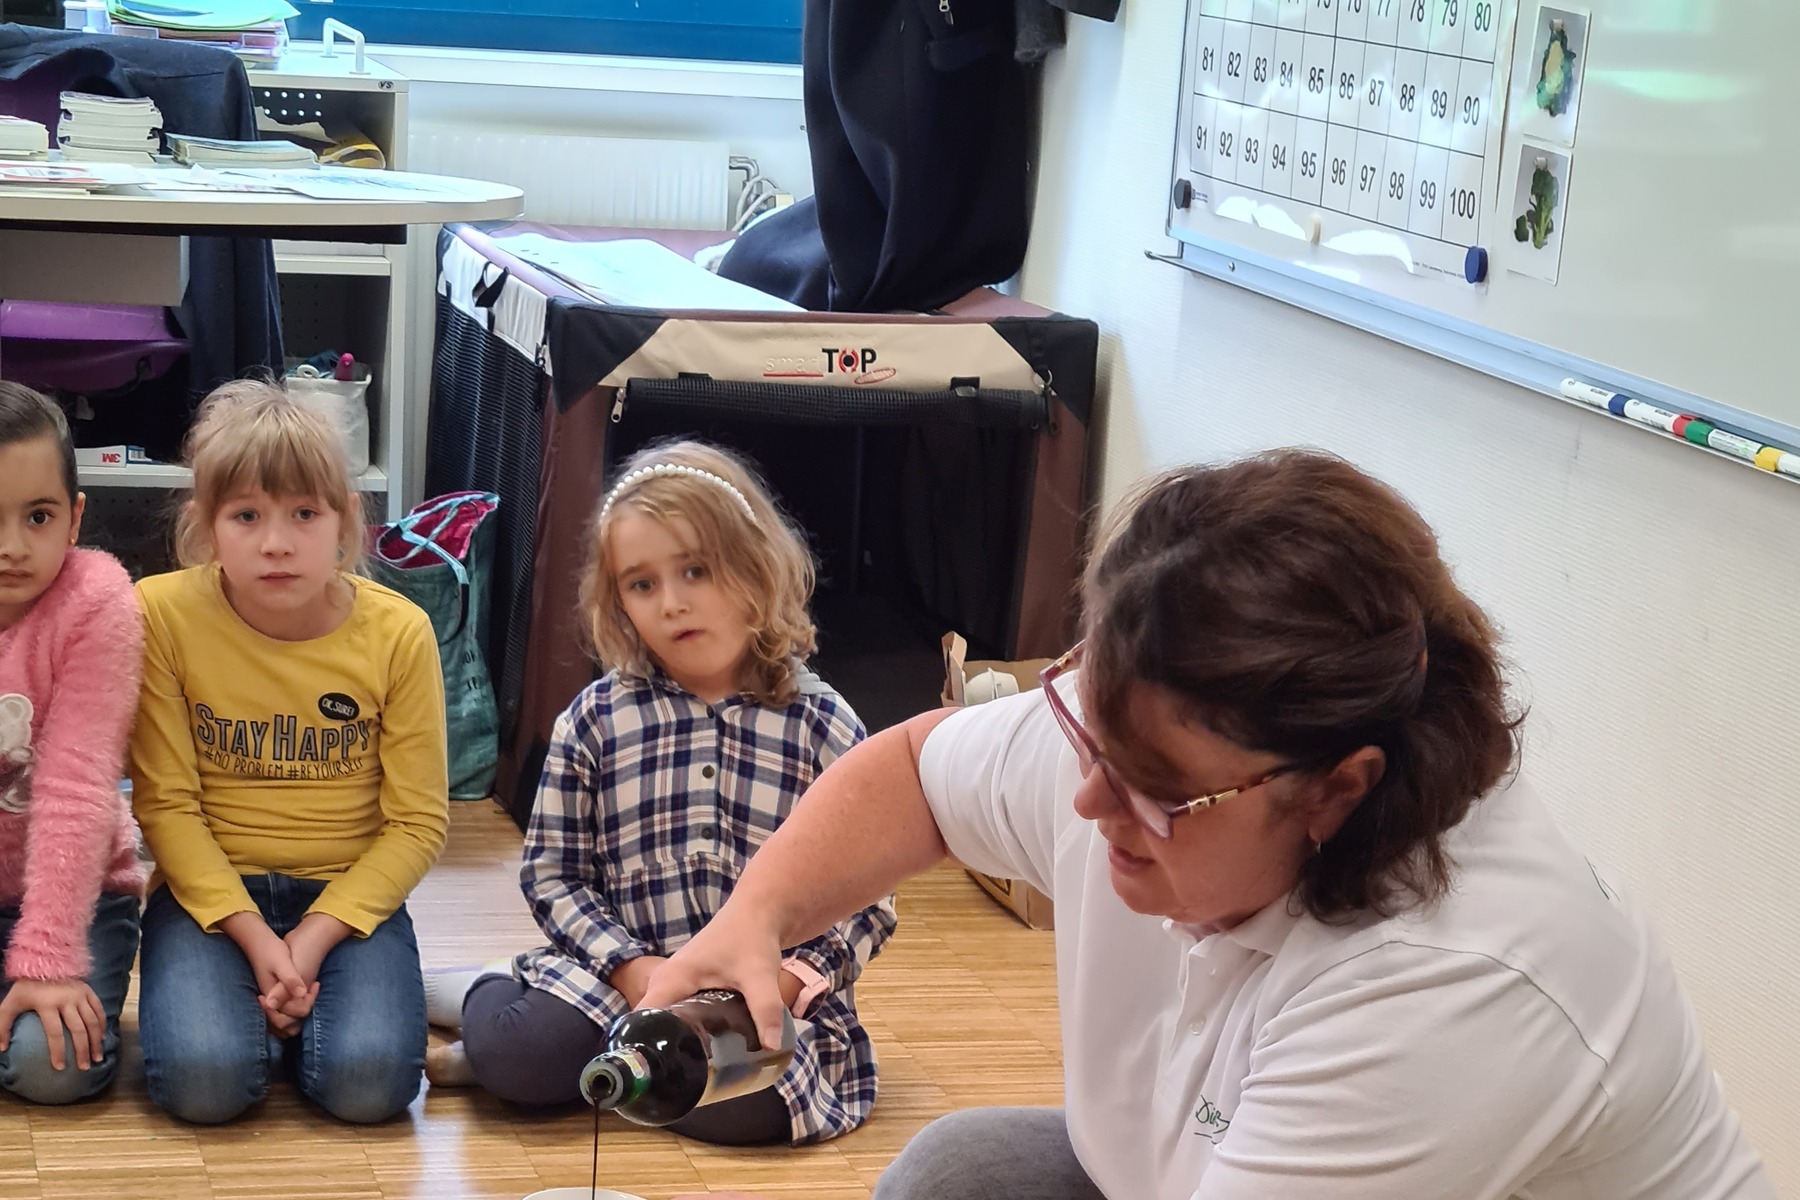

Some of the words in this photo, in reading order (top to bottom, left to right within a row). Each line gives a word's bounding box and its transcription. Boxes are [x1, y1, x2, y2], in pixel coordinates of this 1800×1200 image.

[1409, 0, 1426, 22] 78
[1441, 0, 1459, 27] 79
[1474, 2, 1492, 32] 80
[1202, 46, 1214, 72] 81
[1227, 51, 1241, 77] 82
[1253, 56, 1267, 83] 83
[1280, 61, 1293, 88] 84
[1308, 66, 1325, 94] 85
[1339, 72, 1355, 100] 86
[1368, 78, 1384, 106] 87
[1399, 83, 1415, 112] 88
[1430, 89, 1447, 119] 89
[1463, 95, 1480, 126] 90
[1196, 125, 1208, 151] 91
[1219, 131, 1233, 157] 92
[1244, 137, 1259, 164] 93
[1272, 143, 1286, 171] 94
[1301, 150, 1317, 178] 95
[1331, 157, 1347, 186] 96
[1360, 164, 1376, 193] 97
[1388, 171, 1405, 201] 98
[1419, 179, 1437, 210] 99
[1449, 187, 1476, 220] 100
[821, 347, 878, 373] TOP
[102, 453, 121, 463] 3M
[204, 746, 230, 770] #NO
